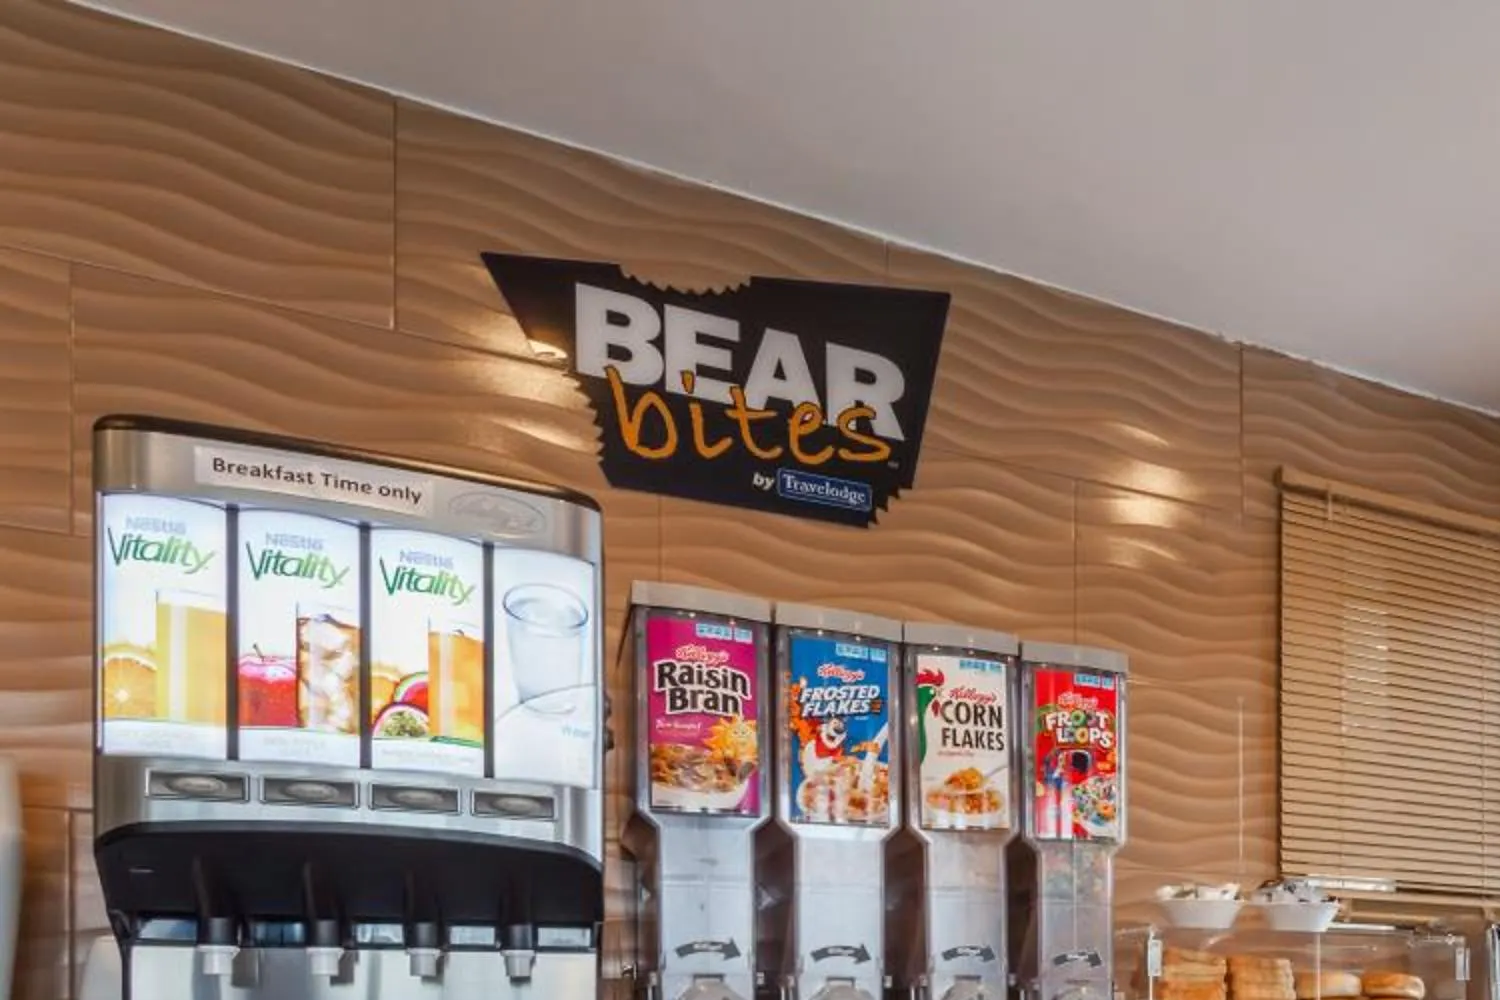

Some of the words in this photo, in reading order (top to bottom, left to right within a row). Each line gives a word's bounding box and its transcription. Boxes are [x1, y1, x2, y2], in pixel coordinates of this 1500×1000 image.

[575, 282, 905, 441] BEAR
[604, 365, 896, 465] bites
[212, 456, 315, 486] Breakfast
[321, 472, 373, 495] Time
[378, 483, 422, 504] only
[753, 472, 774, 490] by
[782, 473, 866, 505] Travelodge
[108, 526, 217, 574] Vitality
[246, 541, 351, 588] Vitality
[379, 556, 475, 606] Vitality
[656, 660, 750, 698] Raisin
[800, 685, 880, 703] FROSTED
[667, 687, 741, 714] Bran
[801, 699, 871, 717] FLAKES
[941, 700, 1003, 729] CORN
[942, 727, 1005, 752] FLAKES
